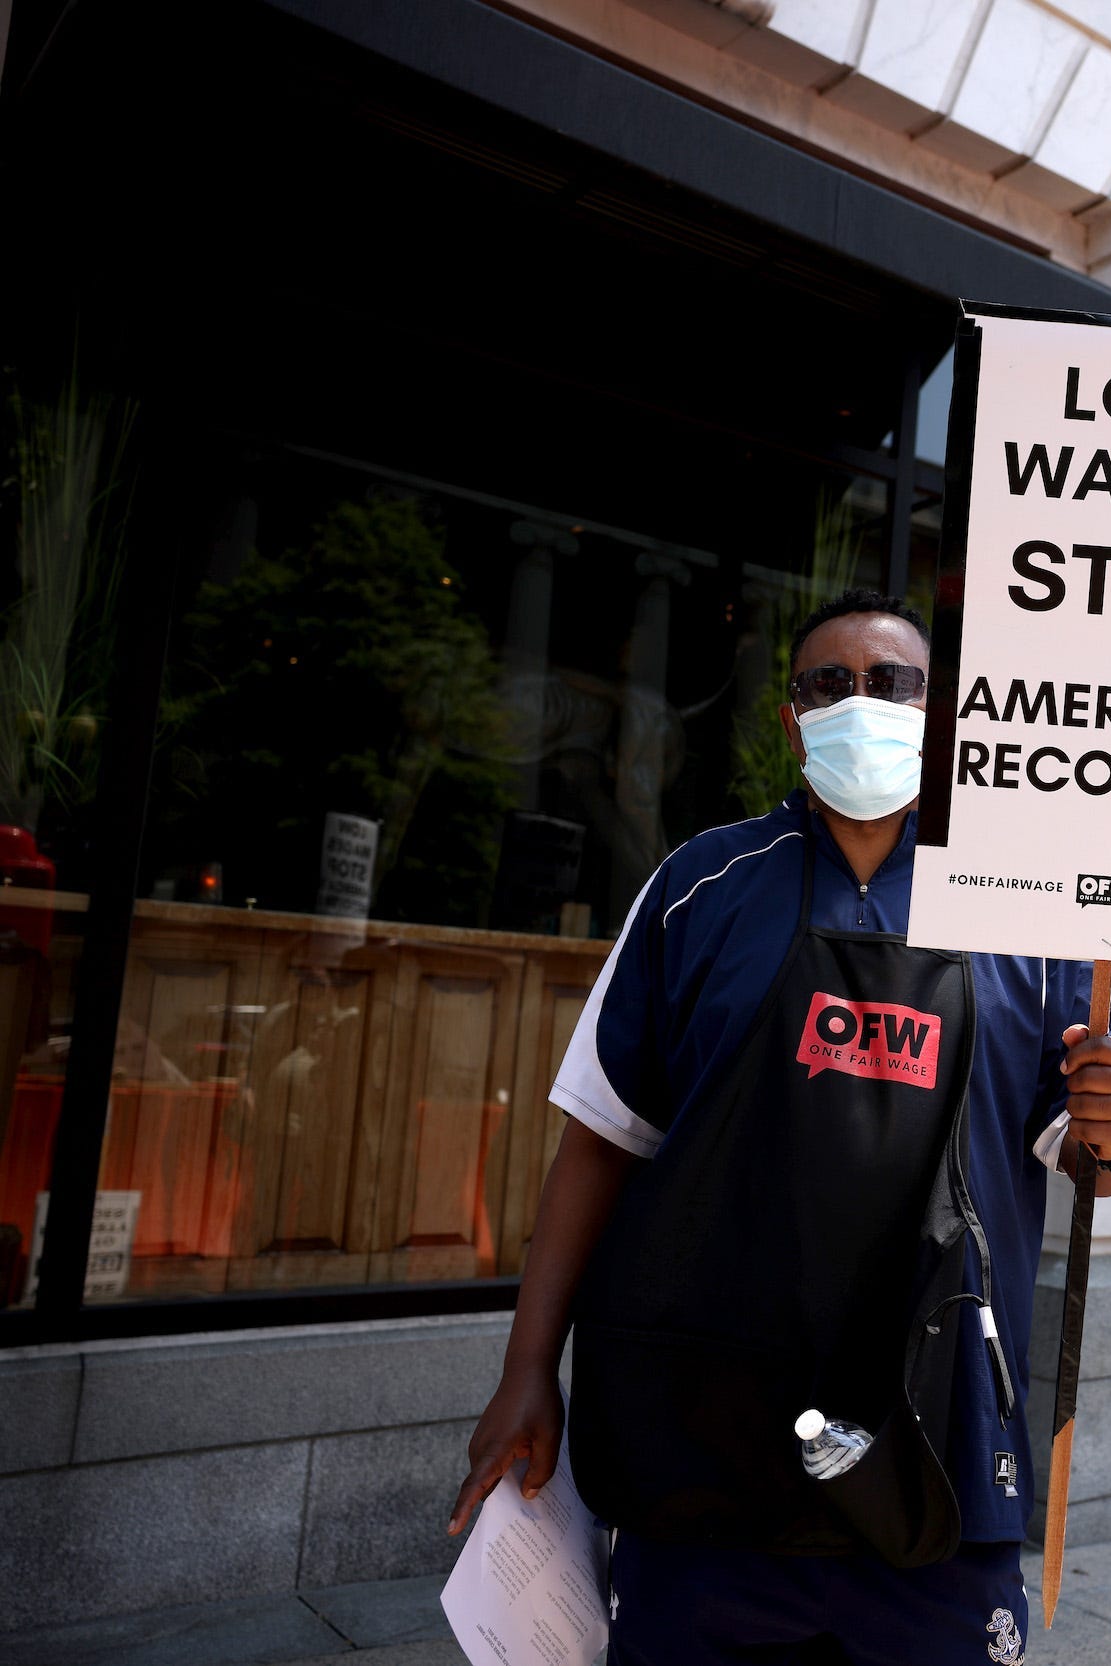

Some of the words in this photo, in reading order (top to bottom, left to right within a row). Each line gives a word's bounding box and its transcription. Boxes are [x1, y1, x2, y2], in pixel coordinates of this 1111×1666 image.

[947, 873, 1065, 893] #ONEFAIRWAGE
[815, 1004, 931, 1060] OFW
[809, 1044, 842, 1060] ONE
[849, 1054, 881, 1069] FAIR
[887, 1058, 928, 1077] WAGE
